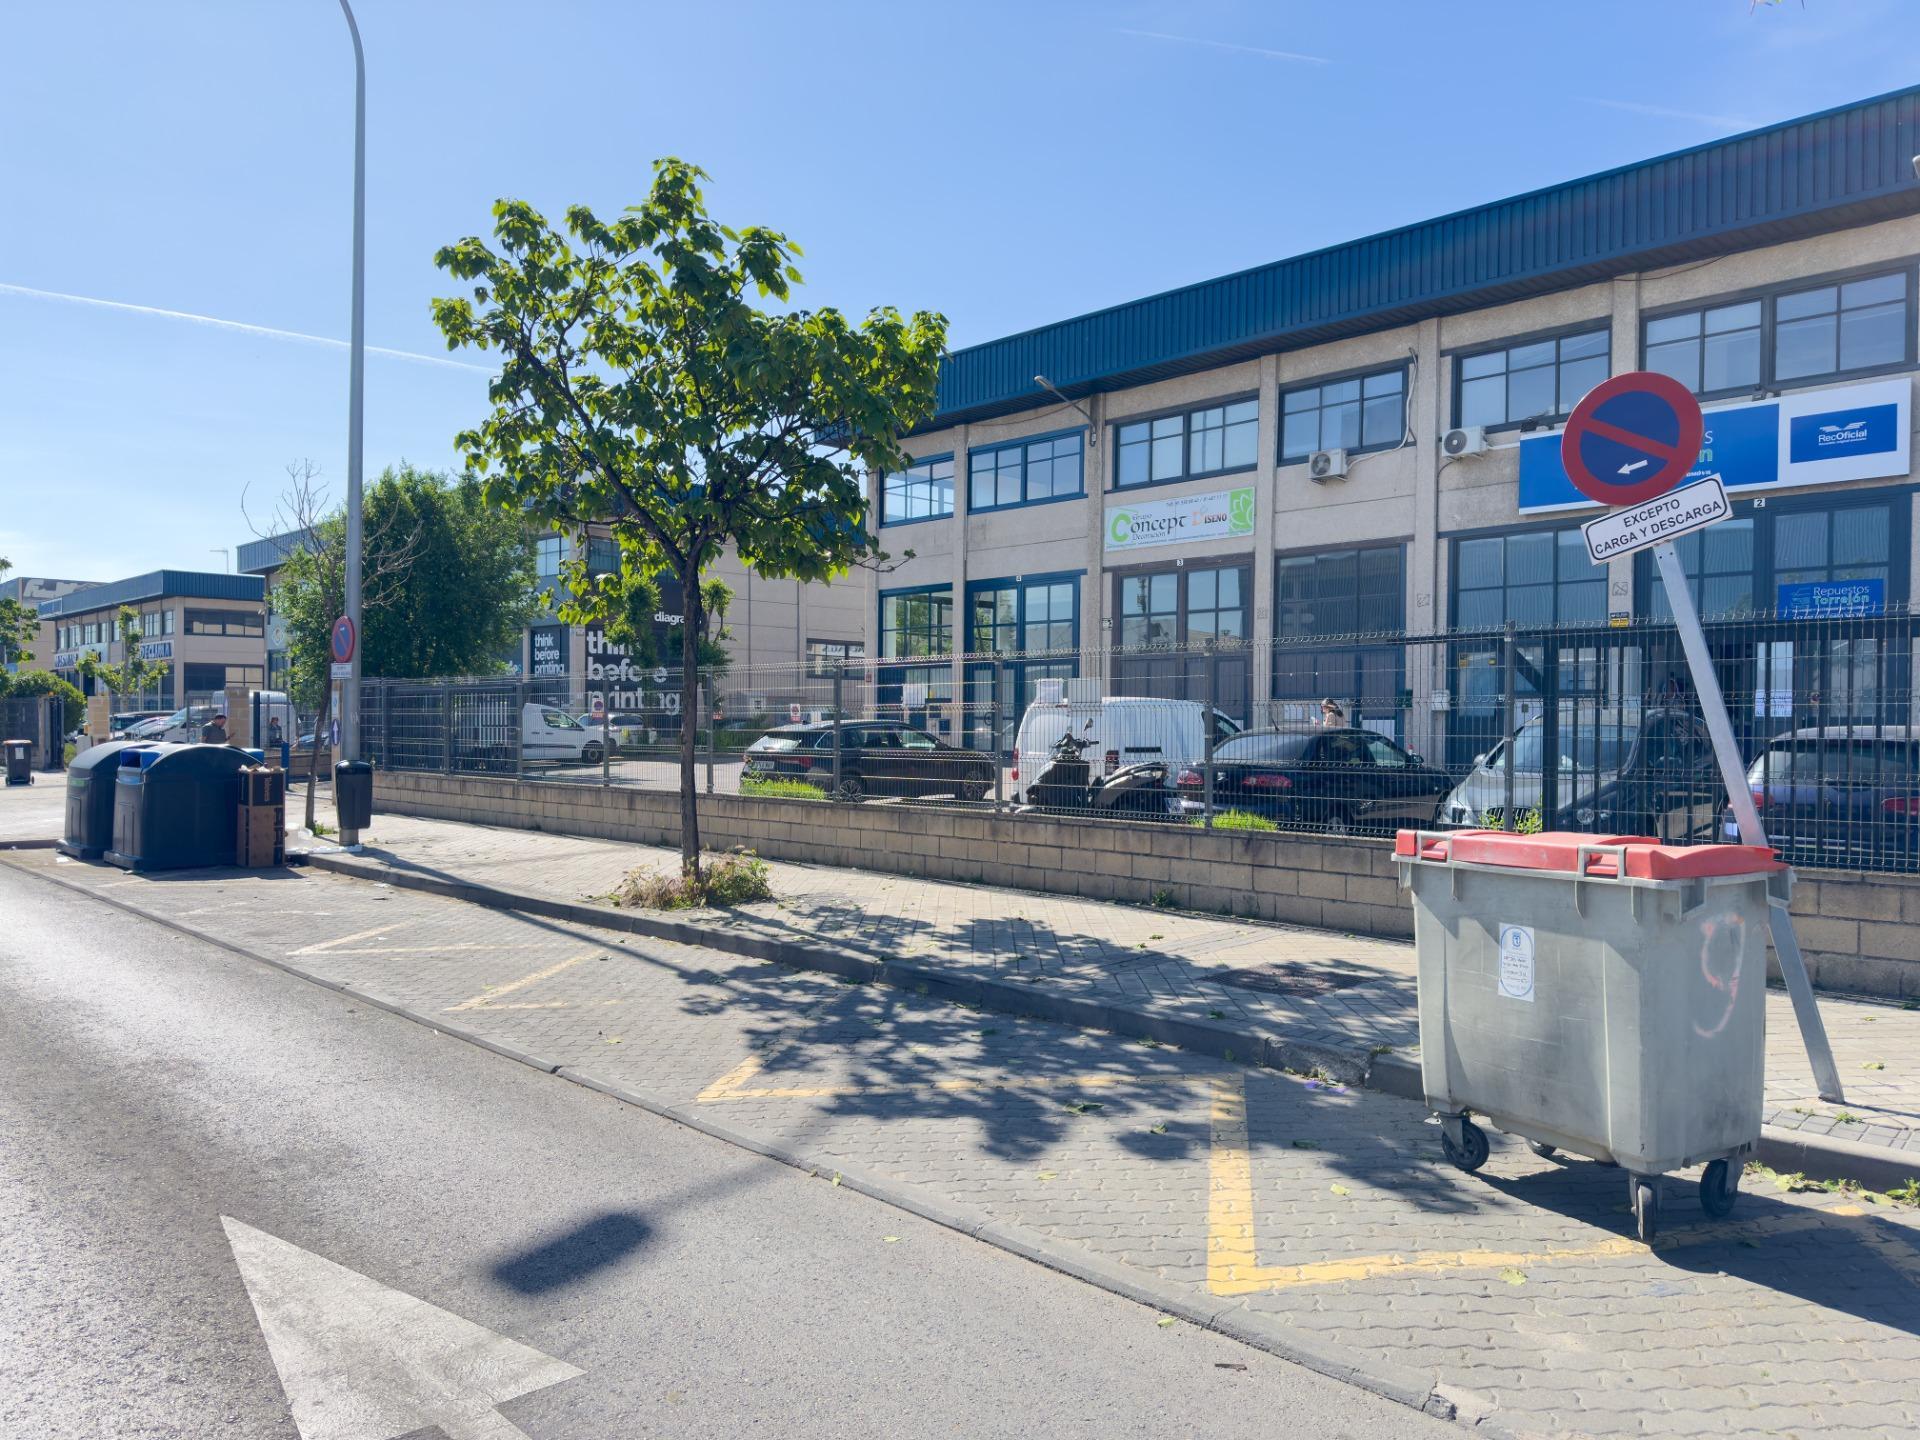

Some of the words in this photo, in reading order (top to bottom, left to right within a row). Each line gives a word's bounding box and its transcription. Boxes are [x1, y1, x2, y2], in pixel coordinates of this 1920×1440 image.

[1818, 429, 1867, 442] RecOficial
[1756, 499, 1763, 507] 2
[1623, 498, 1680, 528] EXCEPTO
[1111, 513, 1187, 542] Concept
[1595, 532, 1638, 554] CARGA
[1639, 527, 1648, 537] Y
[1652, 501, 1722, 534] DESCARGA
[1813, 585, 1870, 597] Repuestos
[534, 633, 554, 647] think
[534, 647, 560, 661] before
[534, 661, 565, 677] printing
[587, 656, 668, 683] befoe
[587, 685, 681, 715] printng
